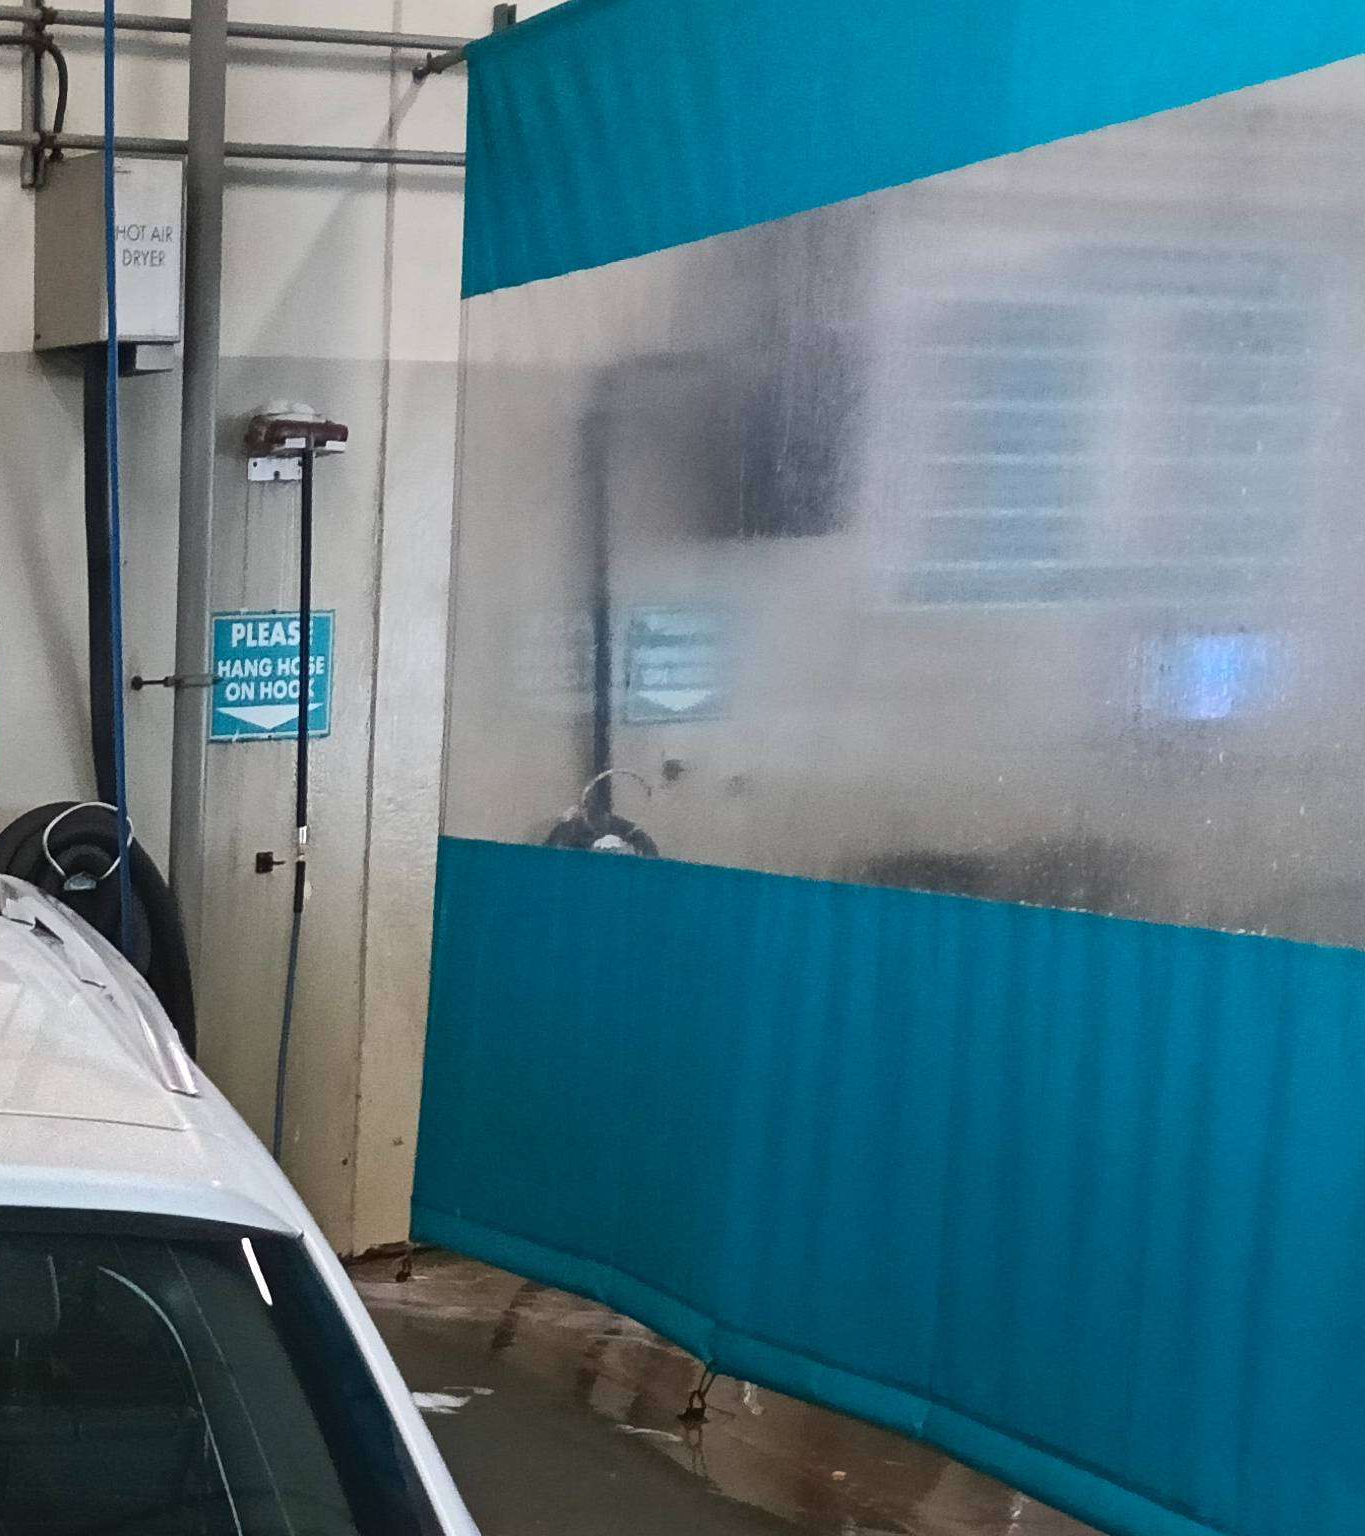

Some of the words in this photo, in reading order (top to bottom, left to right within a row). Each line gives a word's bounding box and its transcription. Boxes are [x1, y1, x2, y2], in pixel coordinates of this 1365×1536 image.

[116, 225, 146, 240] HOT
[151, 226, 173, 242] AIR
[122, 249, 165, 266] DRYER
[218, 658, 272, 677] HANG
